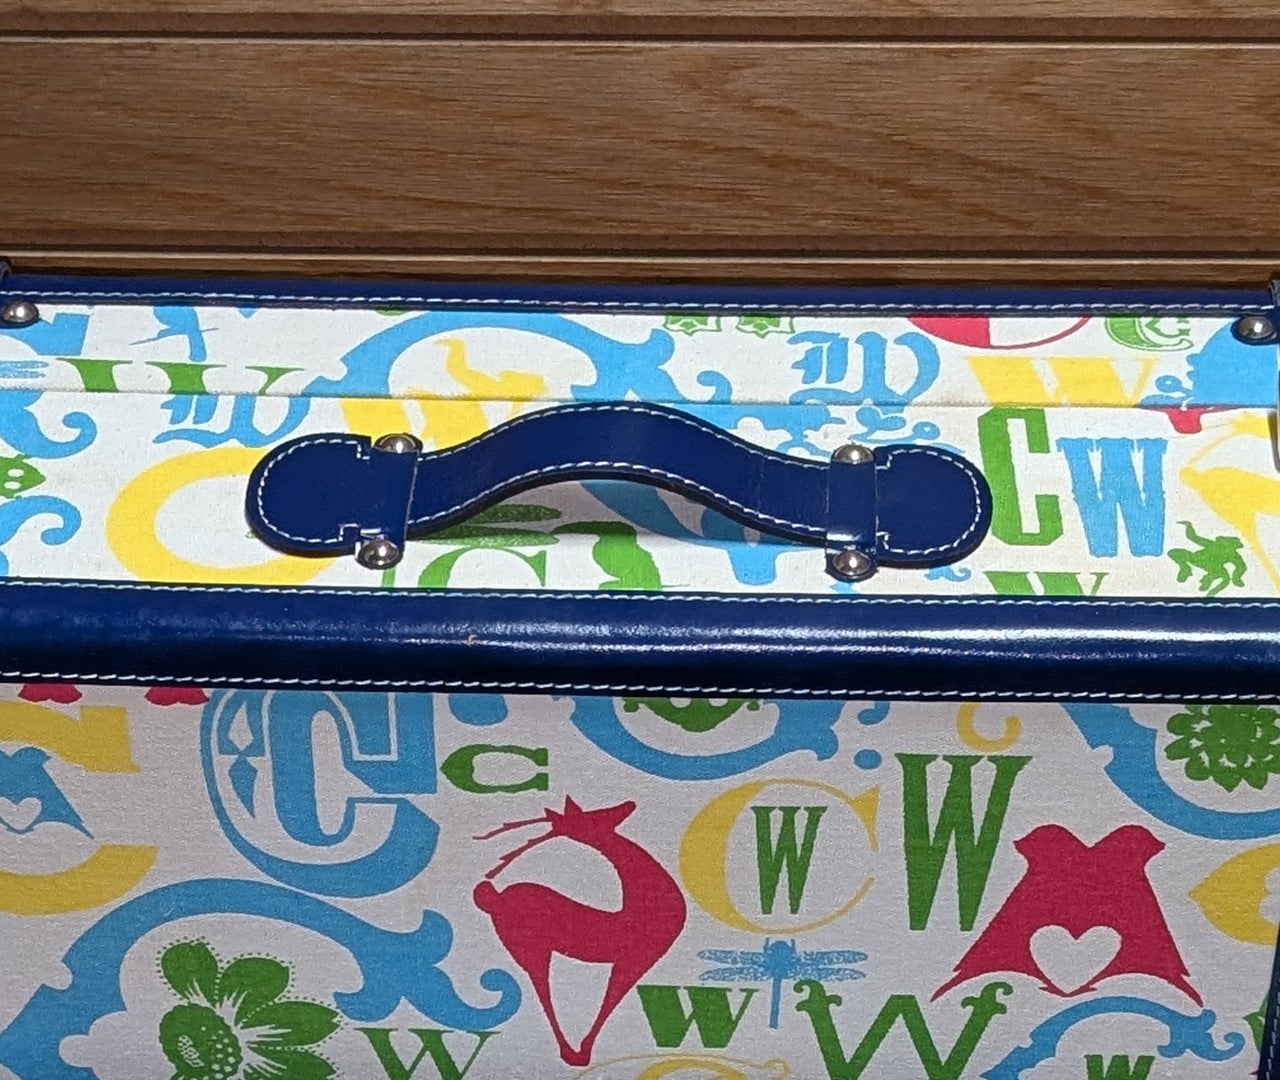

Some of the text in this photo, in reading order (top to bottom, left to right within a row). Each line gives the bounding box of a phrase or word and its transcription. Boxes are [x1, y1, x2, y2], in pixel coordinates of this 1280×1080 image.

[440, 744, 549, 794] C
[679, 778, 881, 935] C
[752, 806, 827, 915] W
[895, 753, 1033, 932] W
[637, 985, 759, 1048] W
